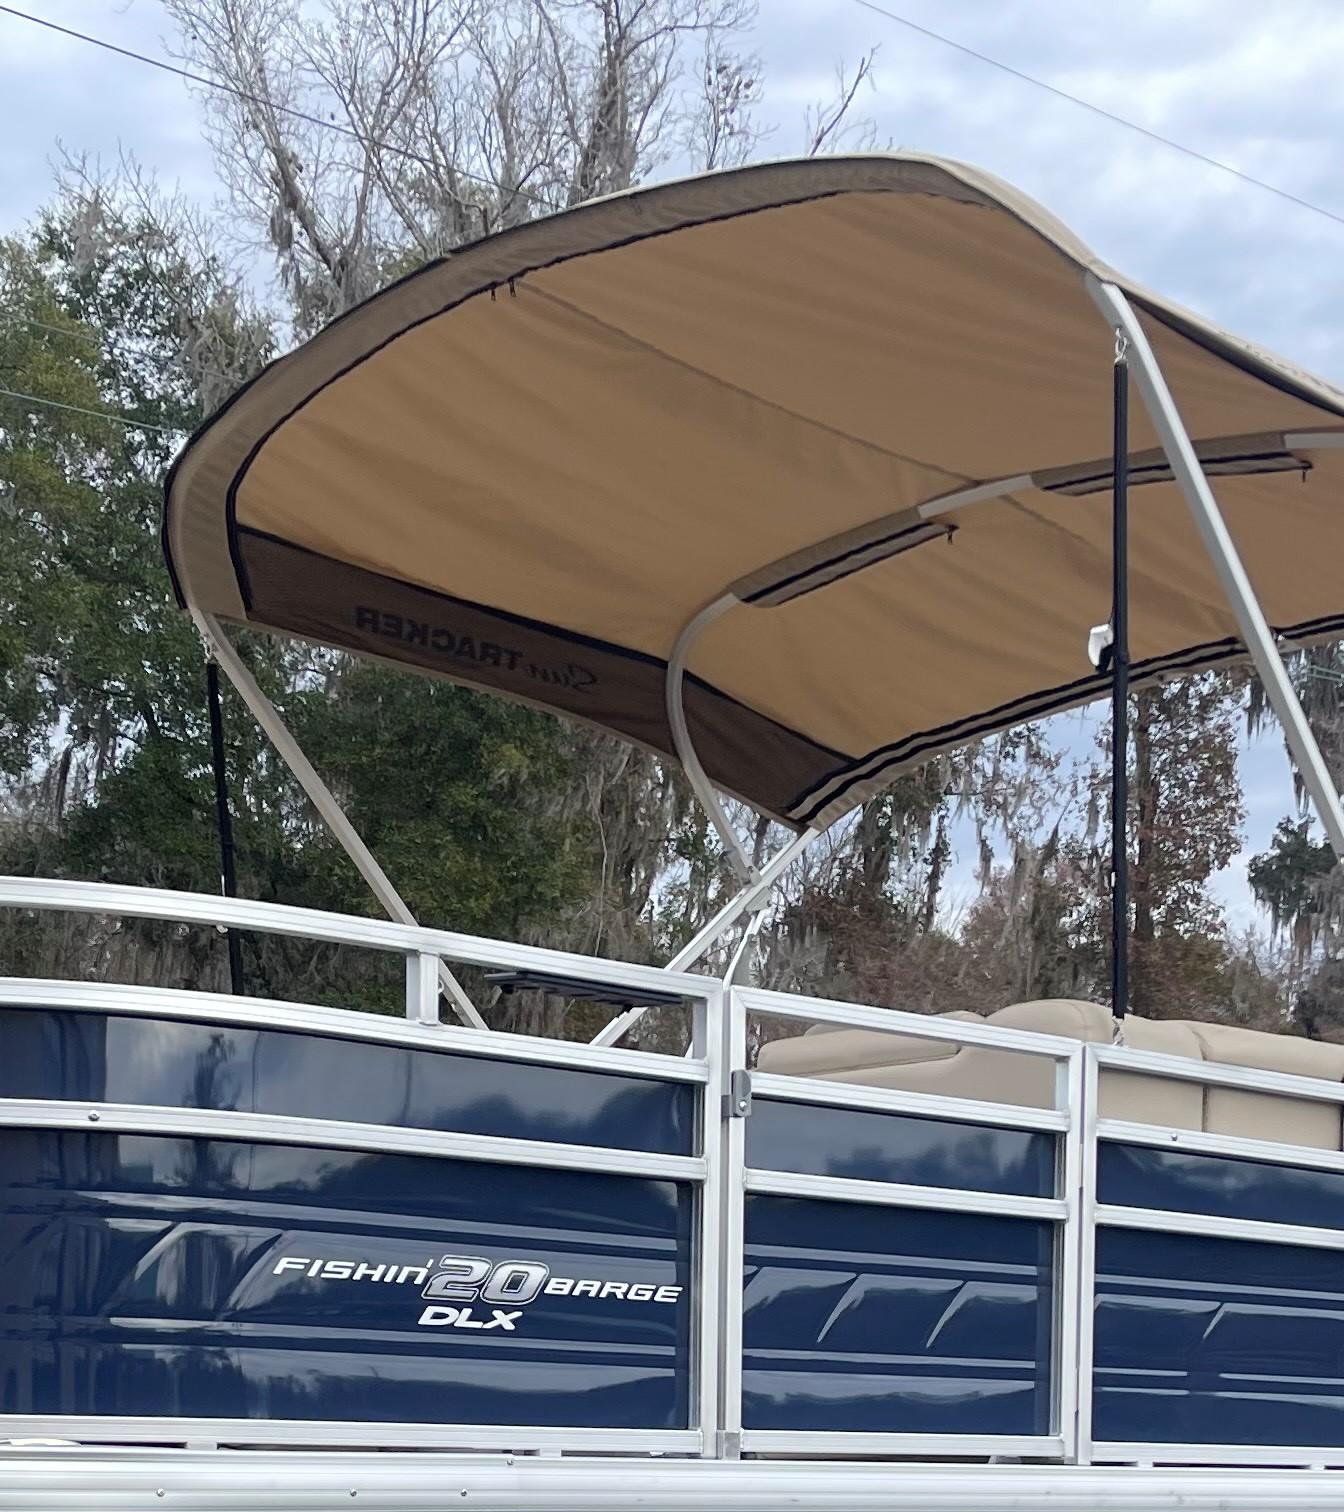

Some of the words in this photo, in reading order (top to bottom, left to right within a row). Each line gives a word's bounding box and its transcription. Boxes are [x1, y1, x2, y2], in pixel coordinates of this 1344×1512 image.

[272, 1257, 434, 1285] FISHIN'
[421, 1254, 550, 1305] 20
[544, 1277, 683, 1303] BARGE
[418, 1305, 523, 1331] DLX
